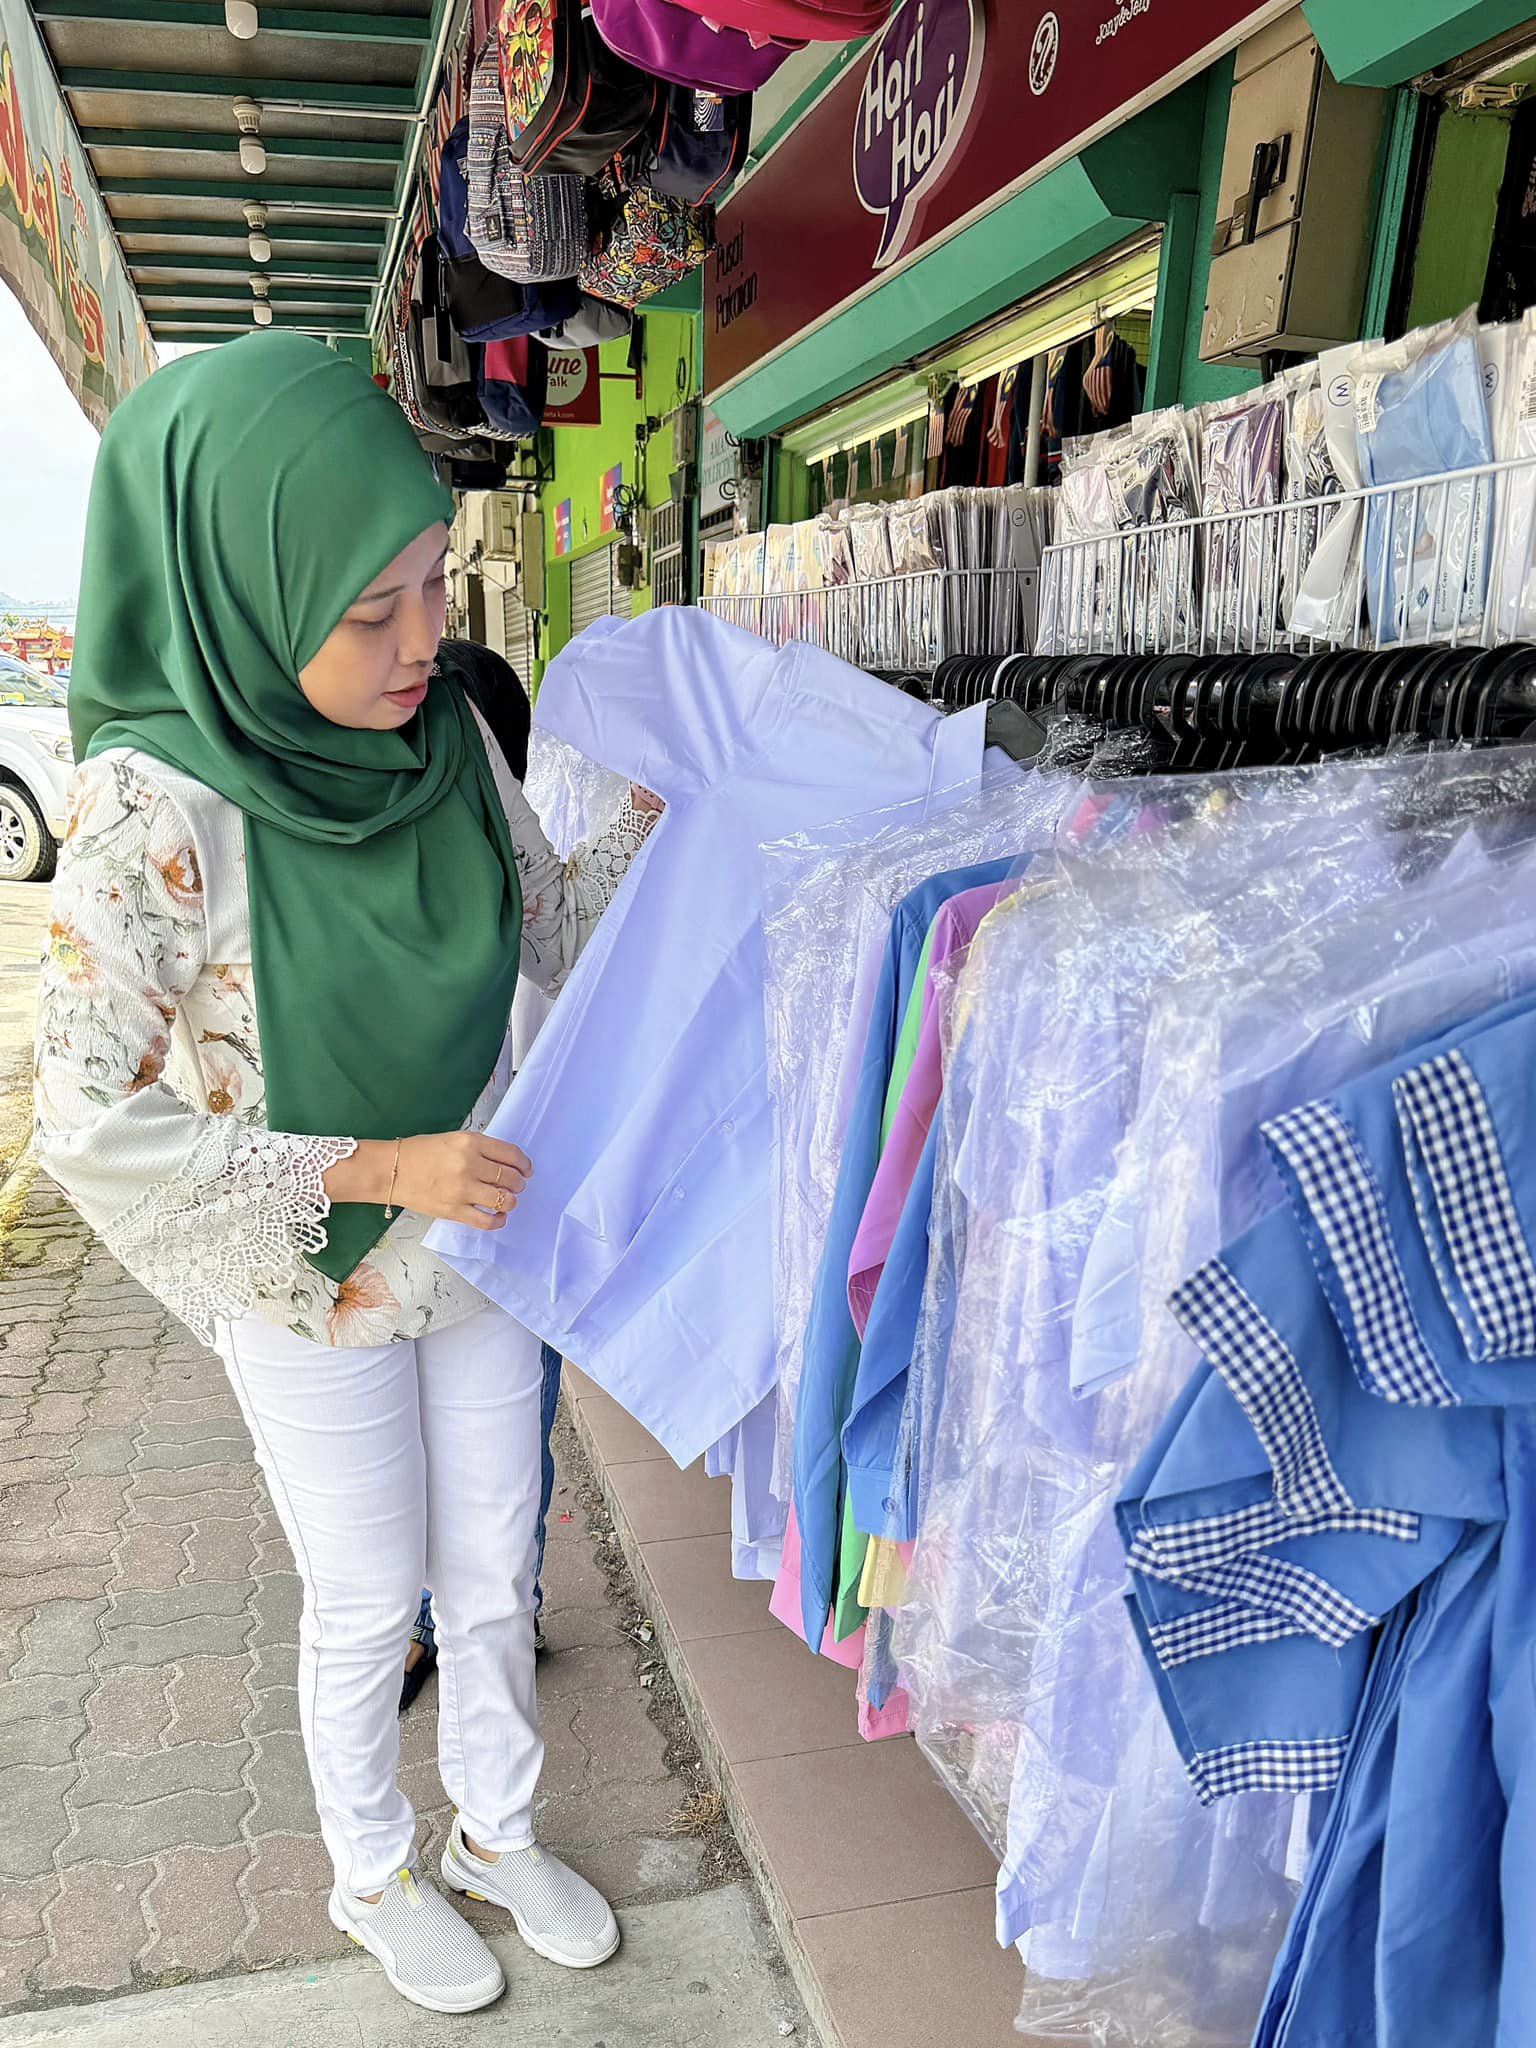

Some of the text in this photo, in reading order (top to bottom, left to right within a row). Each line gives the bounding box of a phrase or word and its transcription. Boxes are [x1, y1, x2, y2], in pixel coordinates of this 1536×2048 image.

[864, 2, 924, 152] Hari
[891, 53, 955, 203] Hari
[716, 220, 744, 283] Pusat
[715, 272, 757, 334] Pakaian
[546, 357, 582, 375] une
[546, 376, 568, 387] alk
[1336, 382, 1349, 397] M
